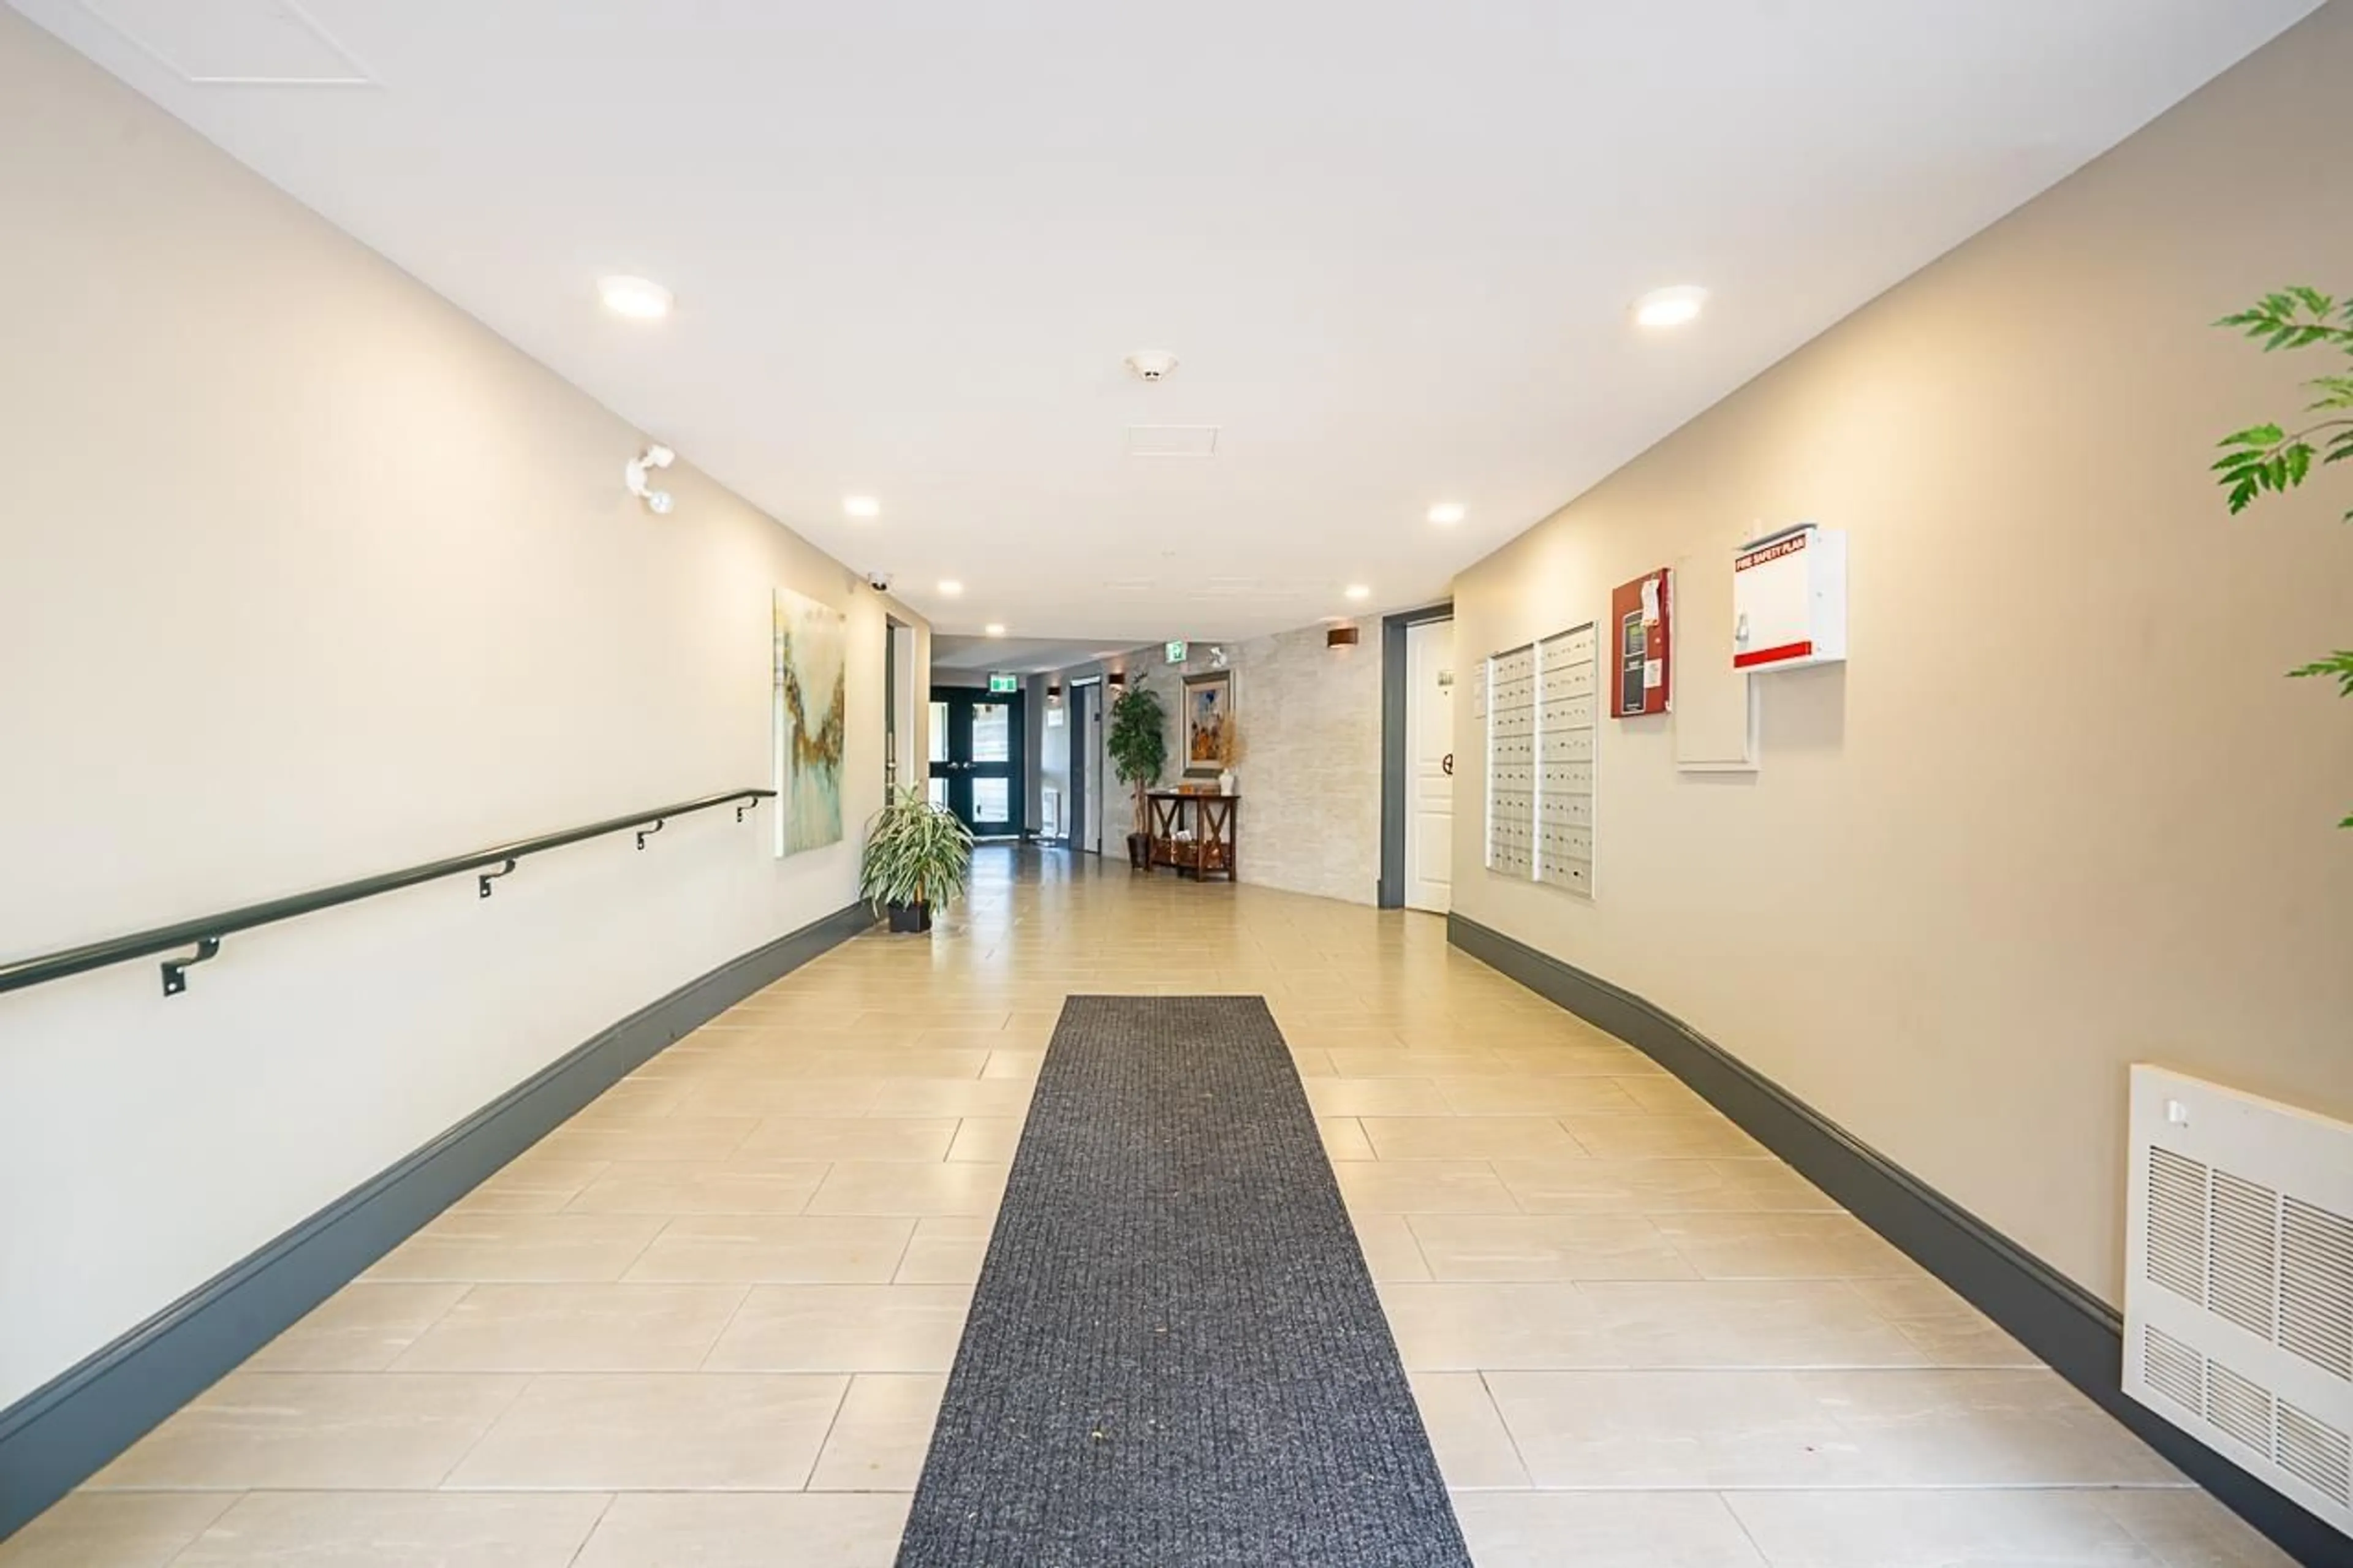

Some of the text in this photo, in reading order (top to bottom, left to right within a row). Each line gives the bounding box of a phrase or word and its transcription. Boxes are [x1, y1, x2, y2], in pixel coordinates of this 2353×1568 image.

[1737, 537, 1805, 570] FIRE SAFETY PLAN
